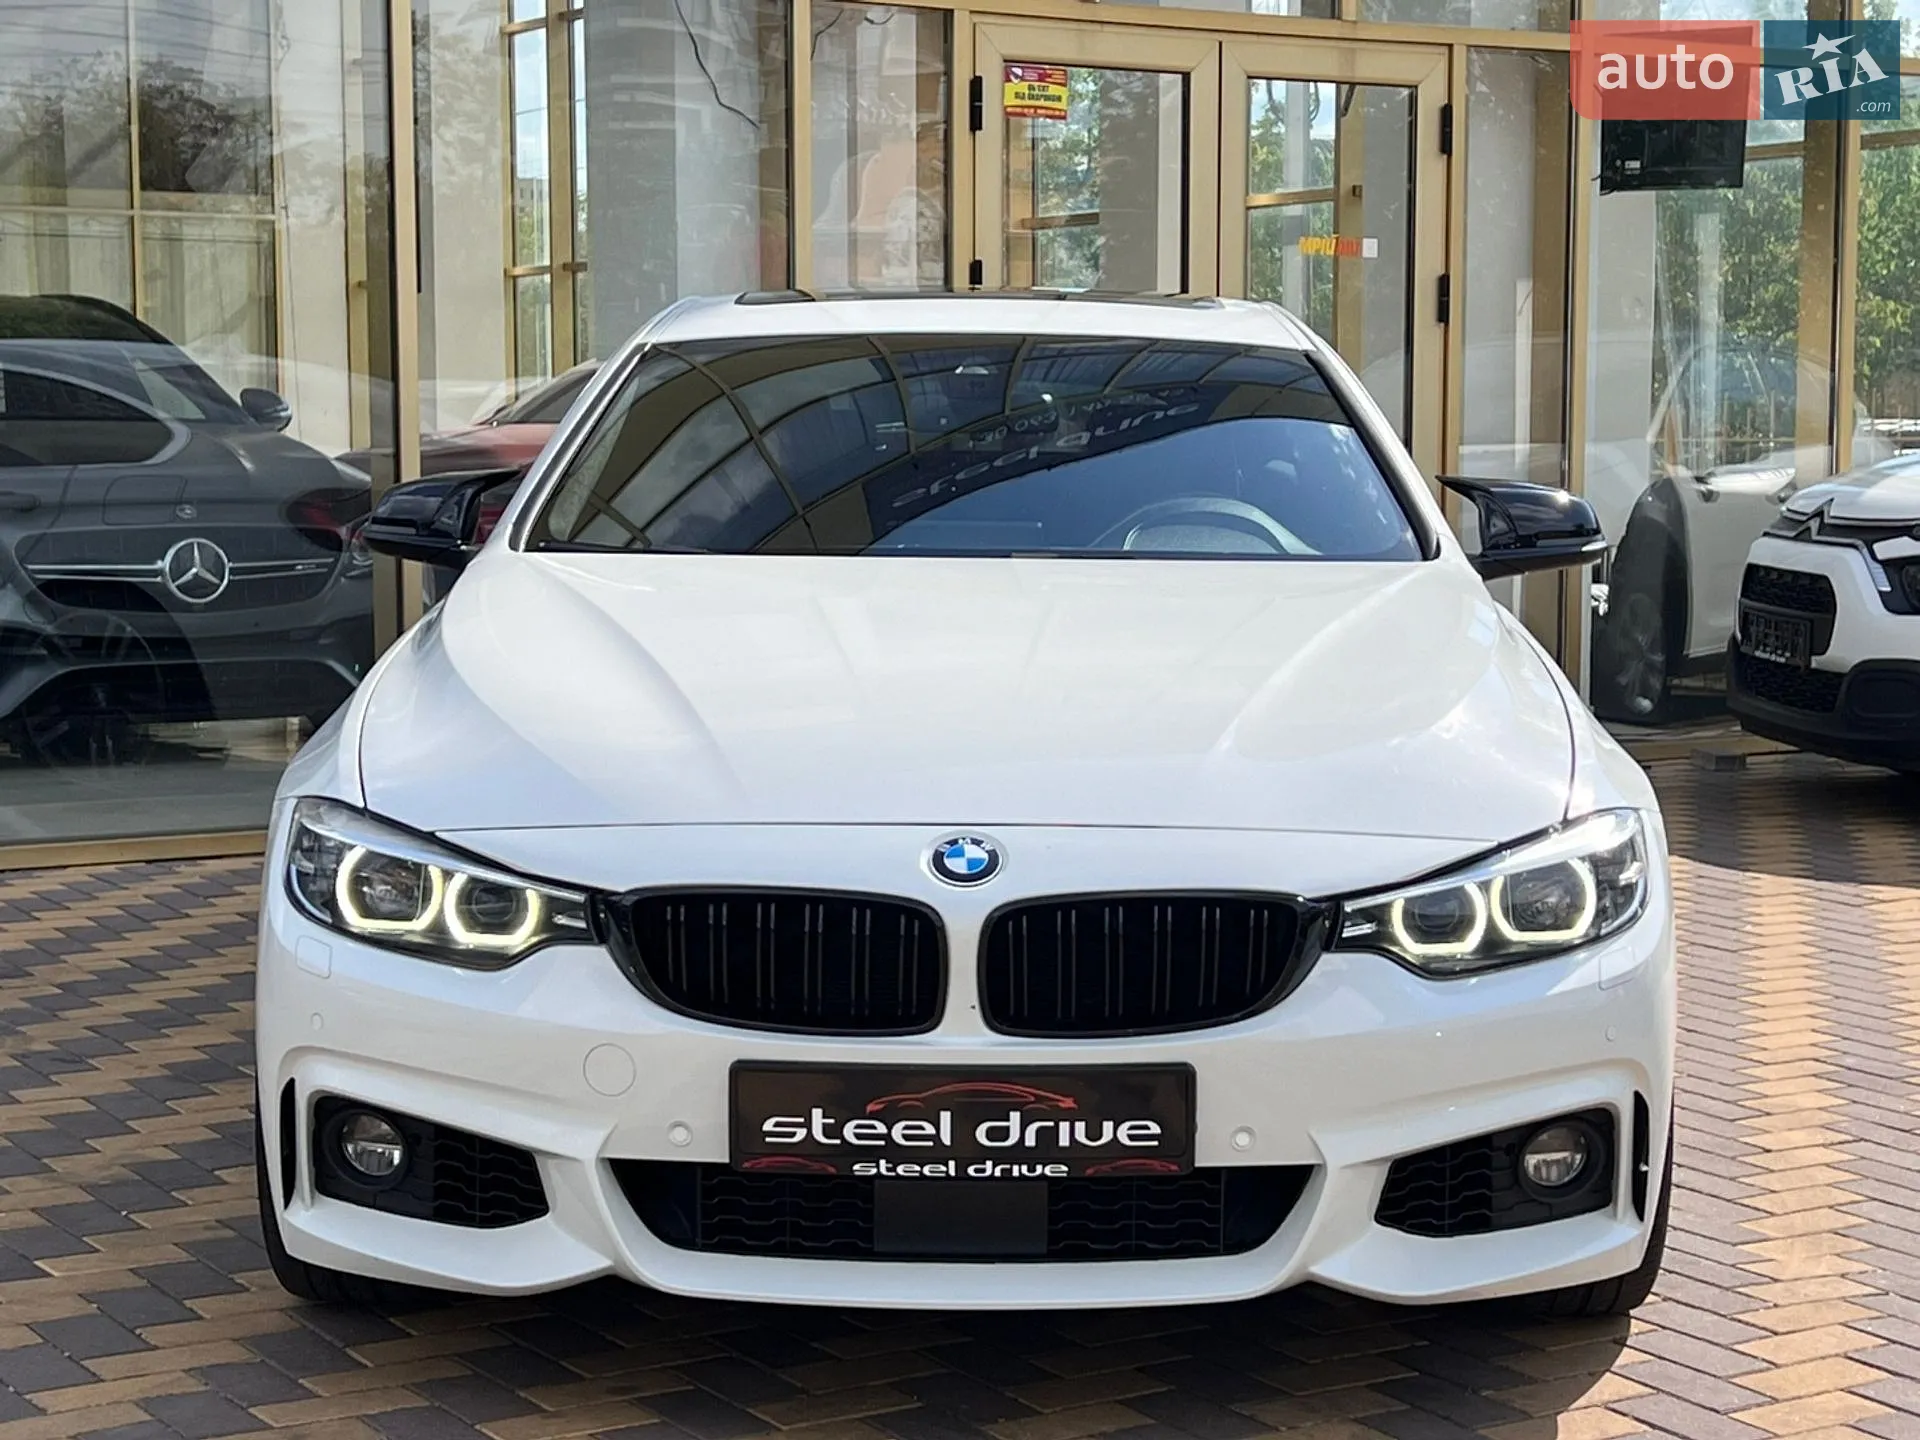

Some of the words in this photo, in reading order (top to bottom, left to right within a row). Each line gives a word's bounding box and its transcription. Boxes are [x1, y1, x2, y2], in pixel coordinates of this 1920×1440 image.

[762, 1108, 951, 1147] steel
[975, 1111, 1161, 1147] drive
[853, 1159, 956, 1177] steel
[967, 1160, 1068, 1177] drive
